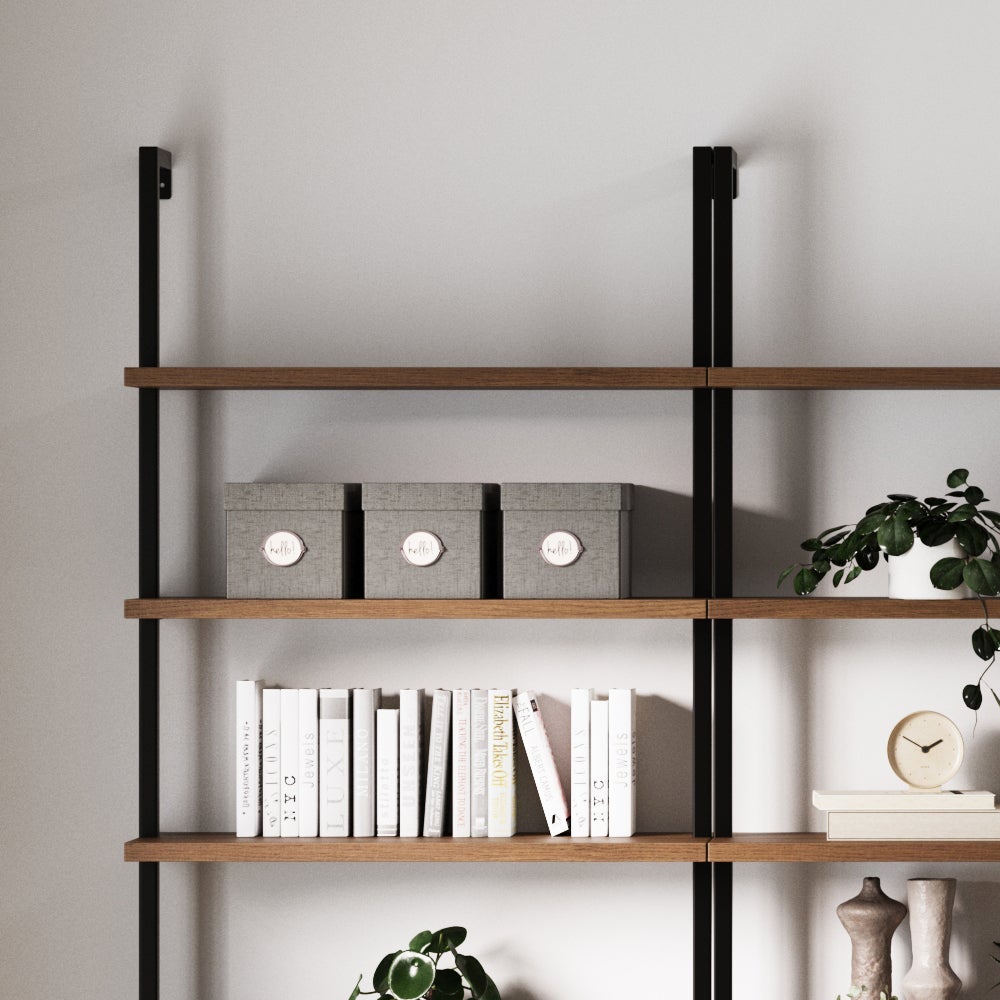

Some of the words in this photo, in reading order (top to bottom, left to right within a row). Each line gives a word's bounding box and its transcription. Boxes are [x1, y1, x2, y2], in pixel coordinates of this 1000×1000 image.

[493, 695, 510, 741] Elizabeth
[302, 732, 315, 789] Jewels
[326, 728, 345, 831] LUXE
[358, 728, 369, 797] MILANO
[492, 743, 509, 768] Takes
[612, 732, 628, 789] Jewels
